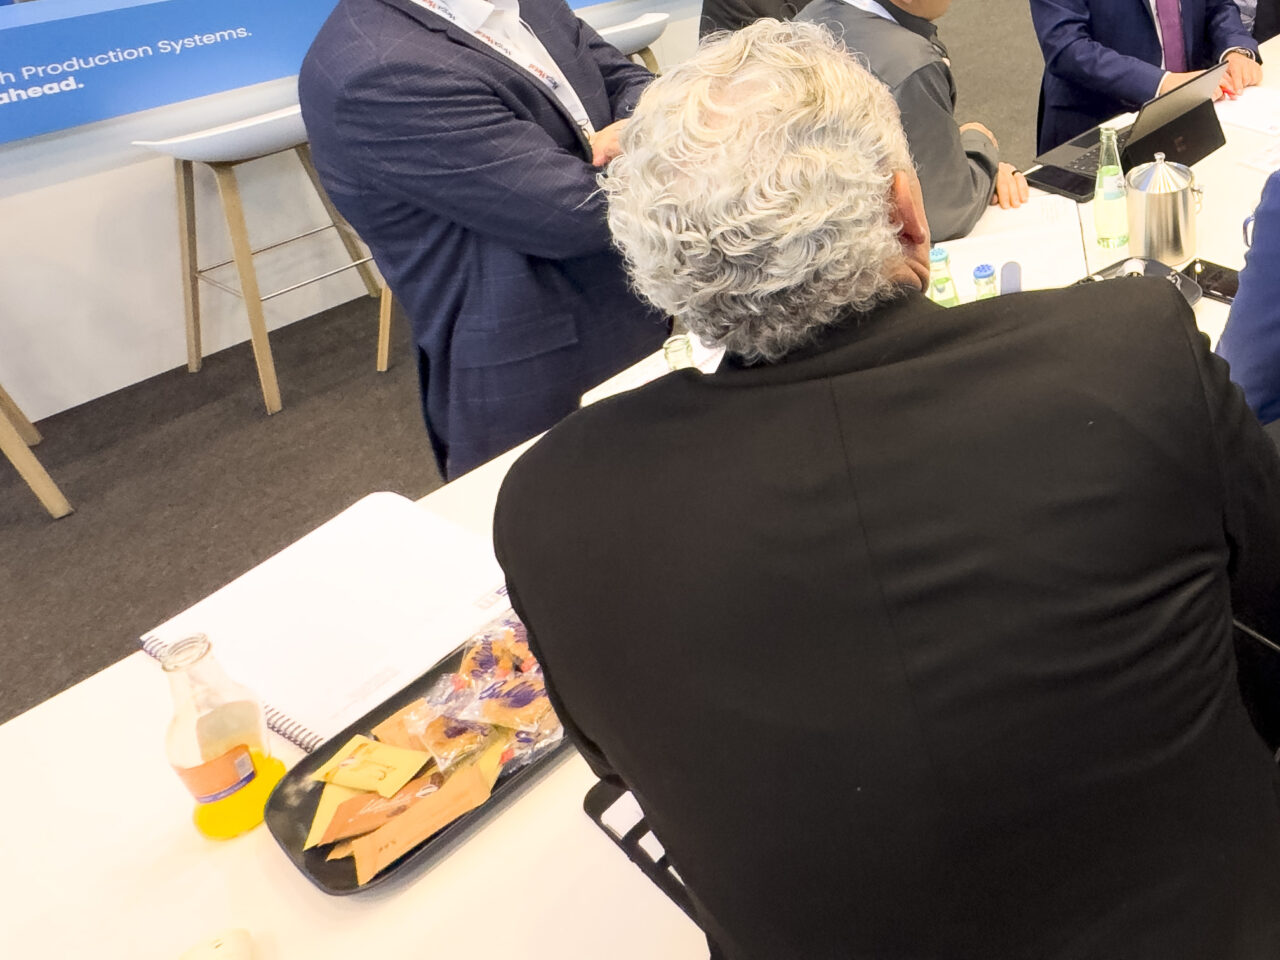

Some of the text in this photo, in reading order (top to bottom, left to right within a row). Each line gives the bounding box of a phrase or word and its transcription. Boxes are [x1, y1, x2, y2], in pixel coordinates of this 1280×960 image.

[21, 45, 153, 82] Production
[158, 26, 252, 55] Systems.
[0, 76, 84, 105] ahead.
